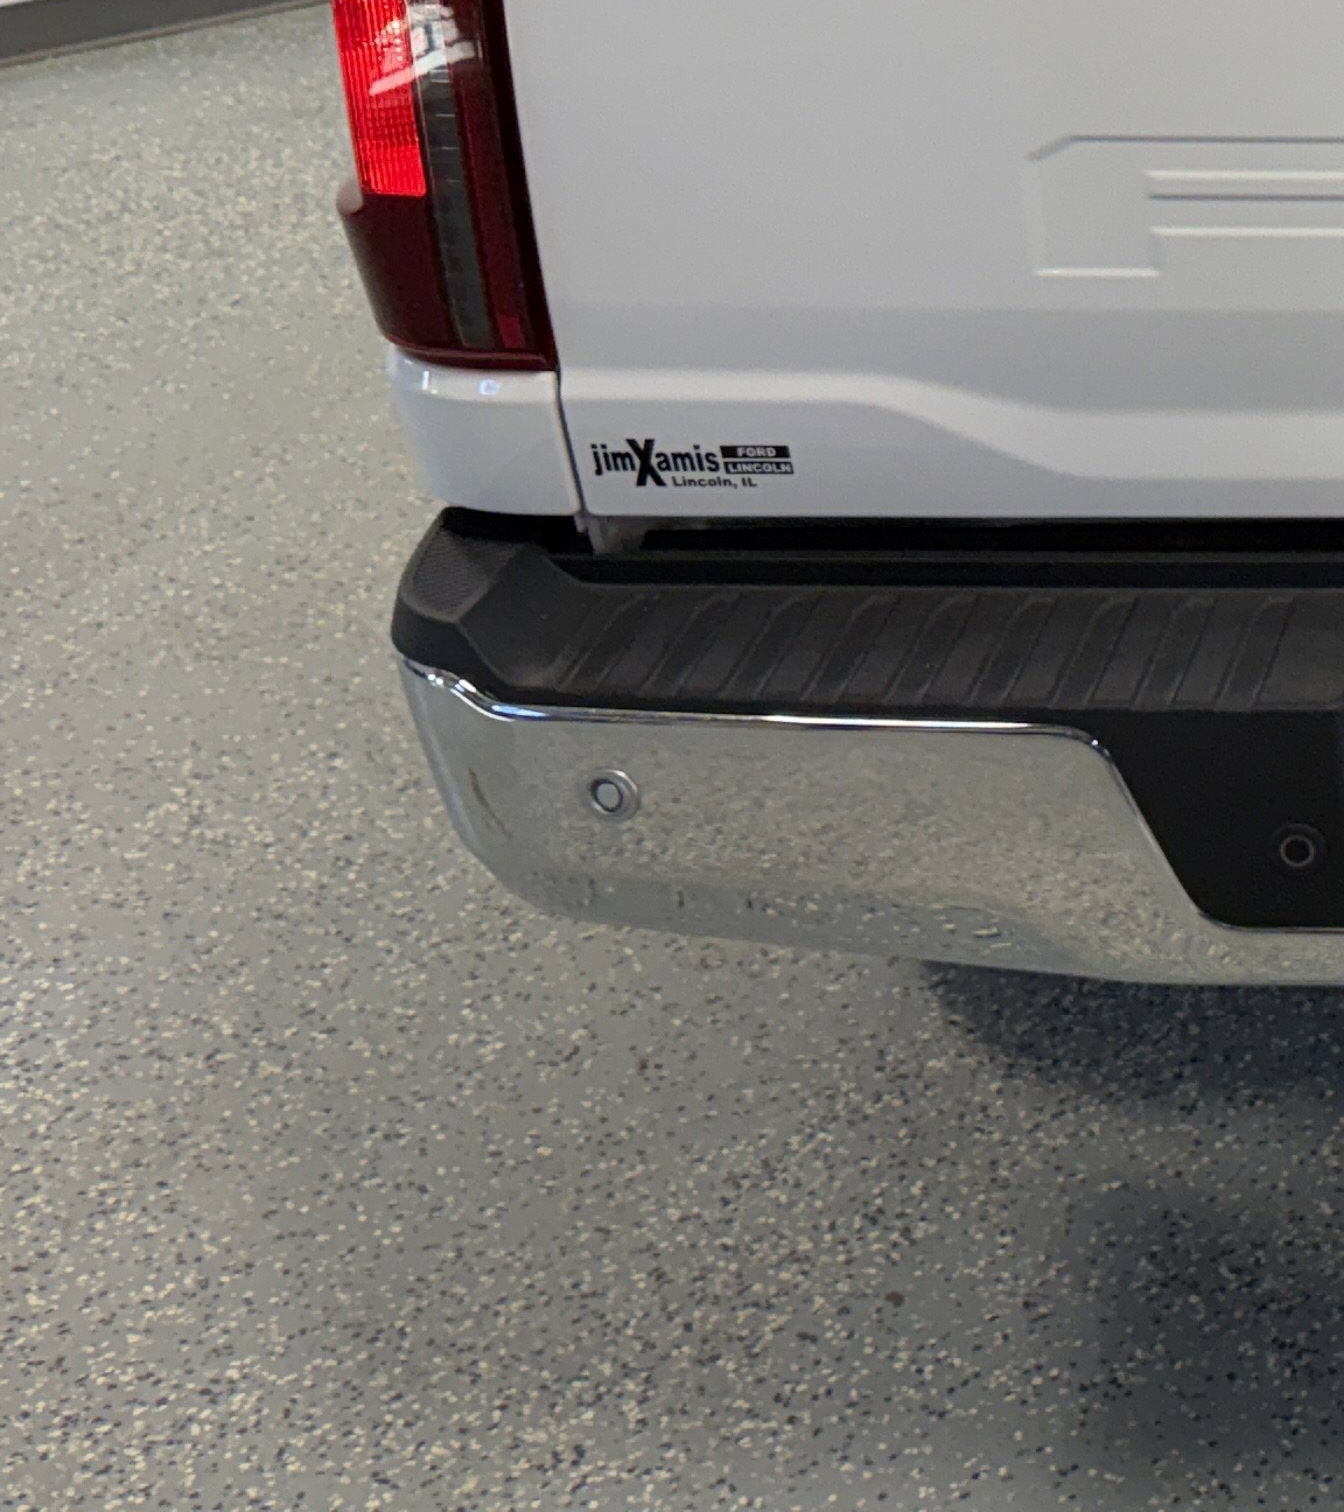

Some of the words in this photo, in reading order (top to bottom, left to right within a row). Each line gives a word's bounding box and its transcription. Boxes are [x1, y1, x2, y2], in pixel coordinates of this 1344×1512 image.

[737, 447, 777, 458] FORD
[727, 461, 792, 473] LINCOLN
[672, 475, 738, 489] Lincoln,
[741, 477, 758, 488] IL
